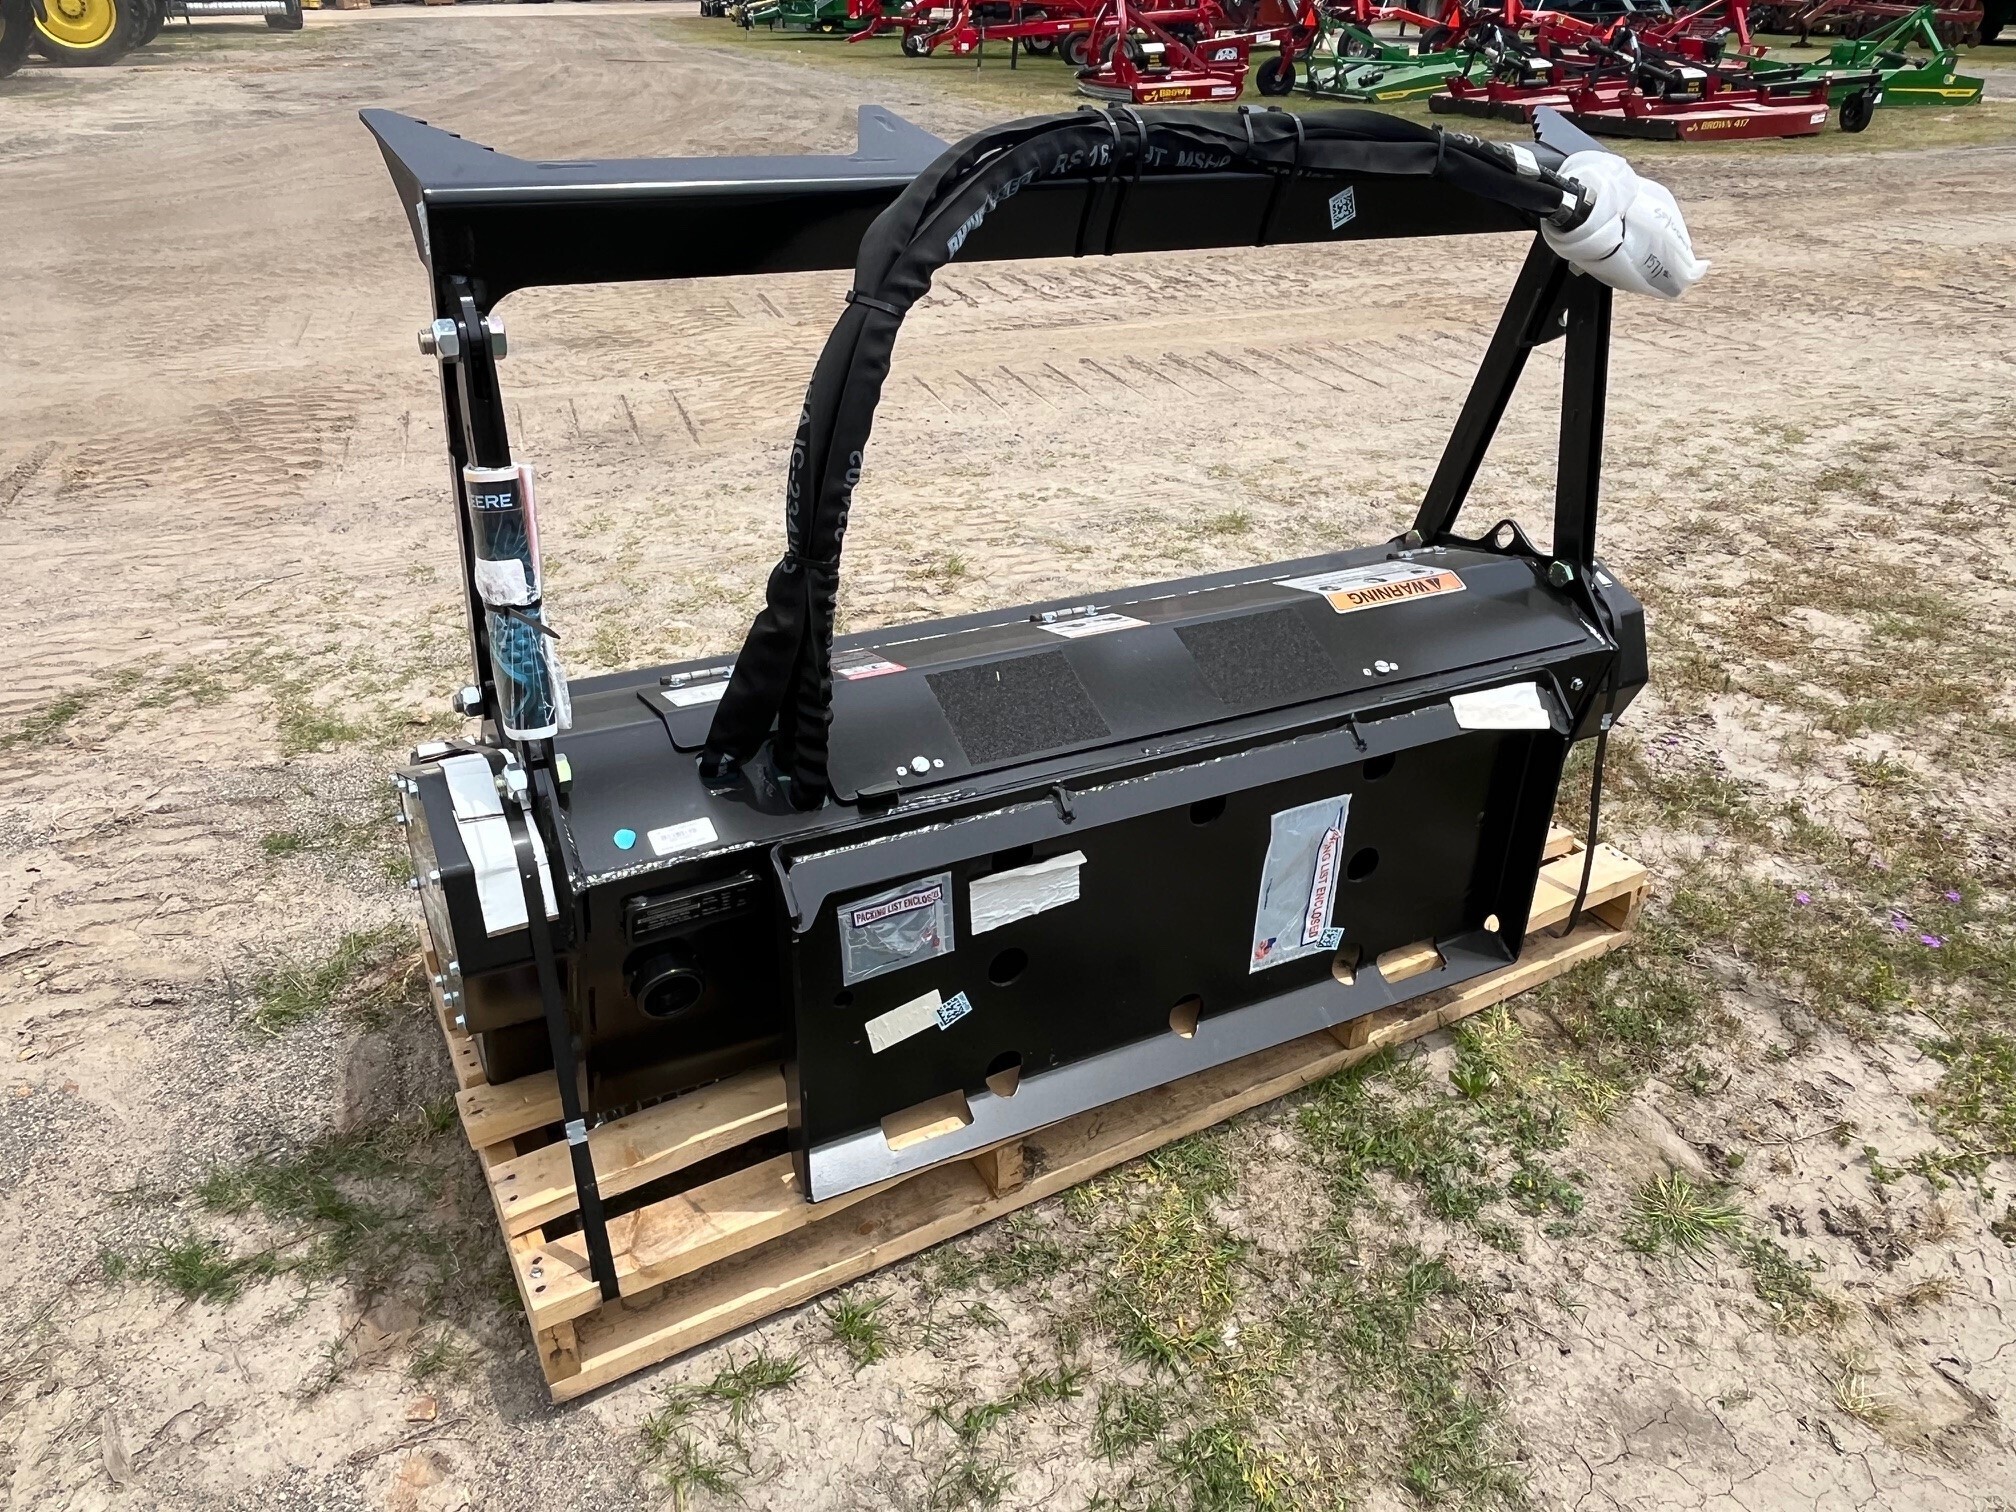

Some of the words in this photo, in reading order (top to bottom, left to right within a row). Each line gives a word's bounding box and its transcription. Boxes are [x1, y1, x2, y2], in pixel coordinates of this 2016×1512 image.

[1160, 88, 1191, 98] BROWN
[1701, 120, 1732, 130] BROWN
[1734, 118, 1750, 128] 417
[1347, 579, 1430, 605] WARNING
[1318, 862, 1330, 883] LIST
[856, 907, 887, 924] PACKING
[887, 901, 902, 914] LIST
[1308, 886, 1326, 939] ENCLOSED
